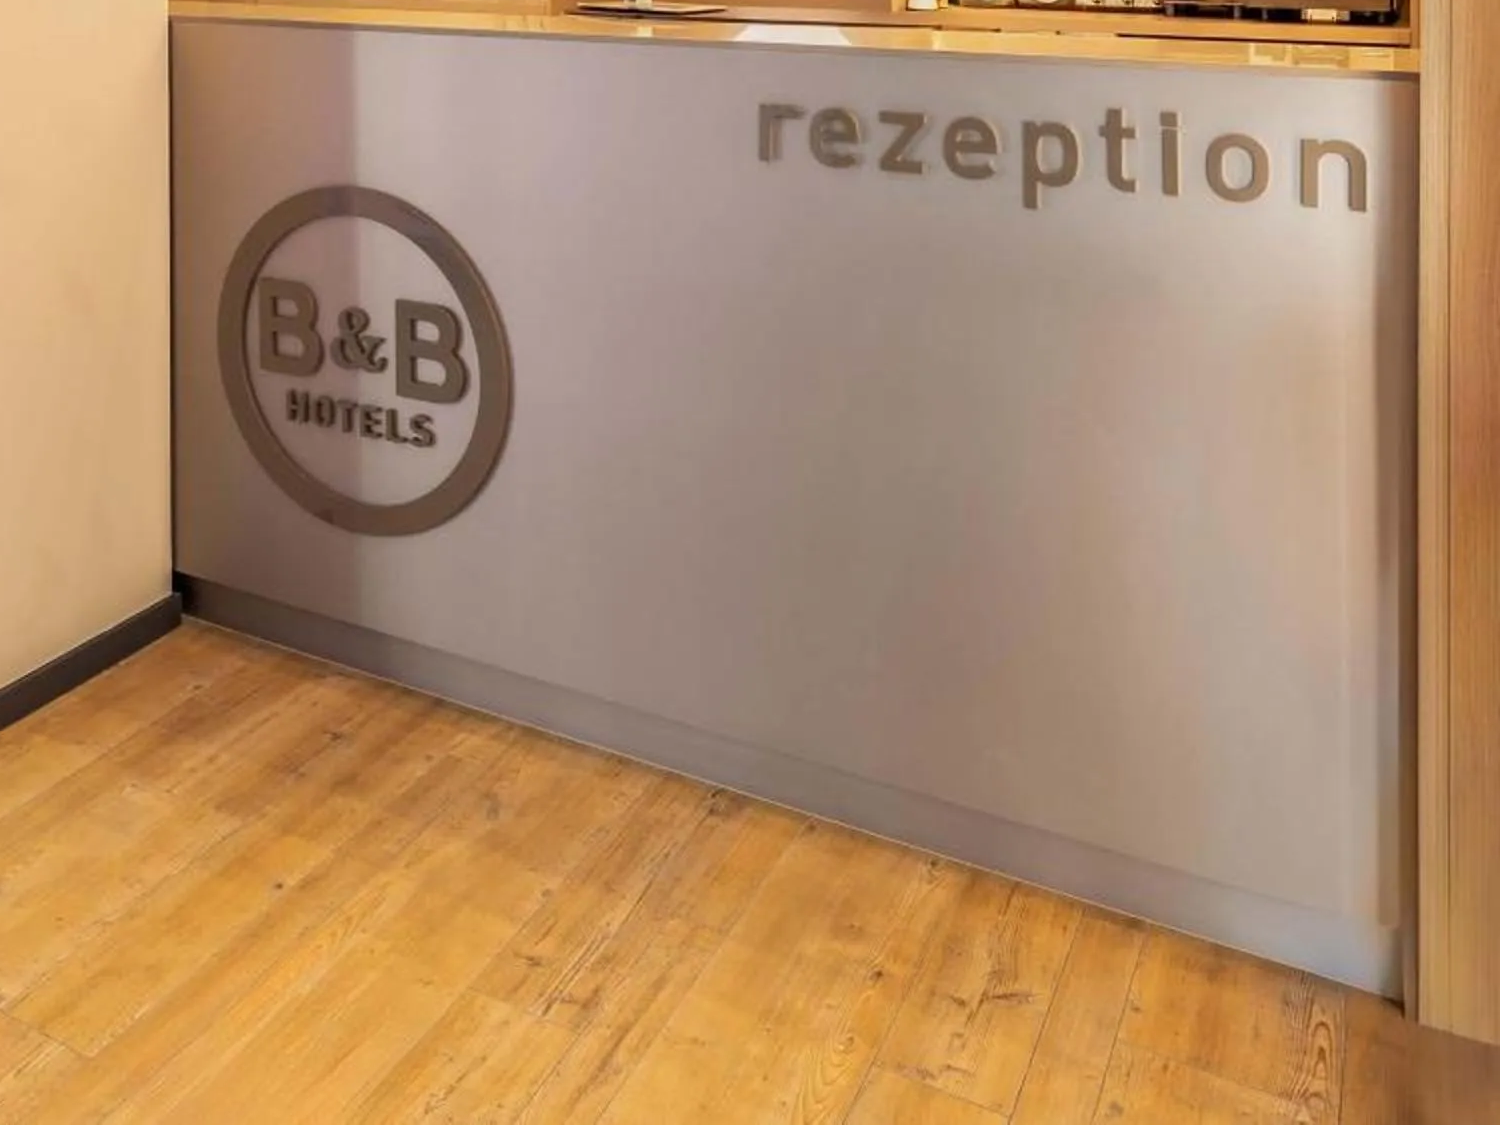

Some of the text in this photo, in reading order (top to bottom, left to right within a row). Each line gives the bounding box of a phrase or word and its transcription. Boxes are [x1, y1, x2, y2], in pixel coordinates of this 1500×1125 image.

[757, 102, 1369, 213] rezeption
[258, 276, 470, 405] B&B
[286, 388, 437, 448] HOTELS
